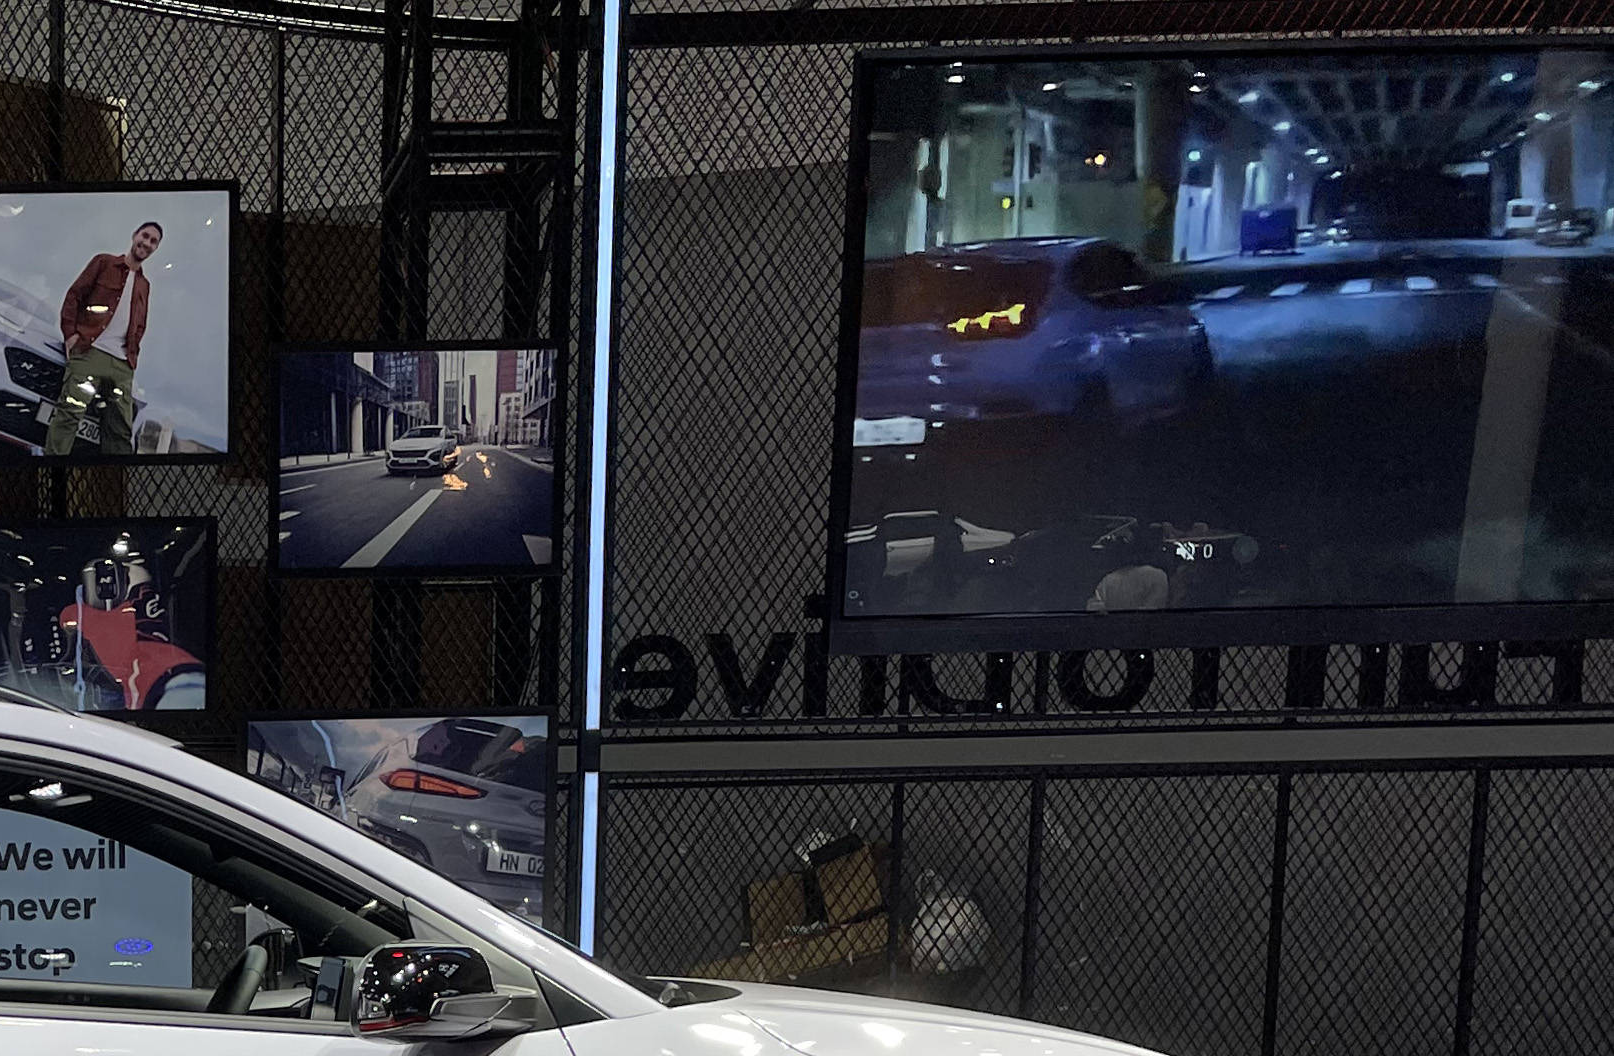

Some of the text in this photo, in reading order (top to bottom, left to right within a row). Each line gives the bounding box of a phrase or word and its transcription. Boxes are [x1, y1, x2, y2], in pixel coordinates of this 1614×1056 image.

[1202, 543, 1214, 559] 0
[62, 838, 126, 870] will
[499, 853, 520, 872] HN
